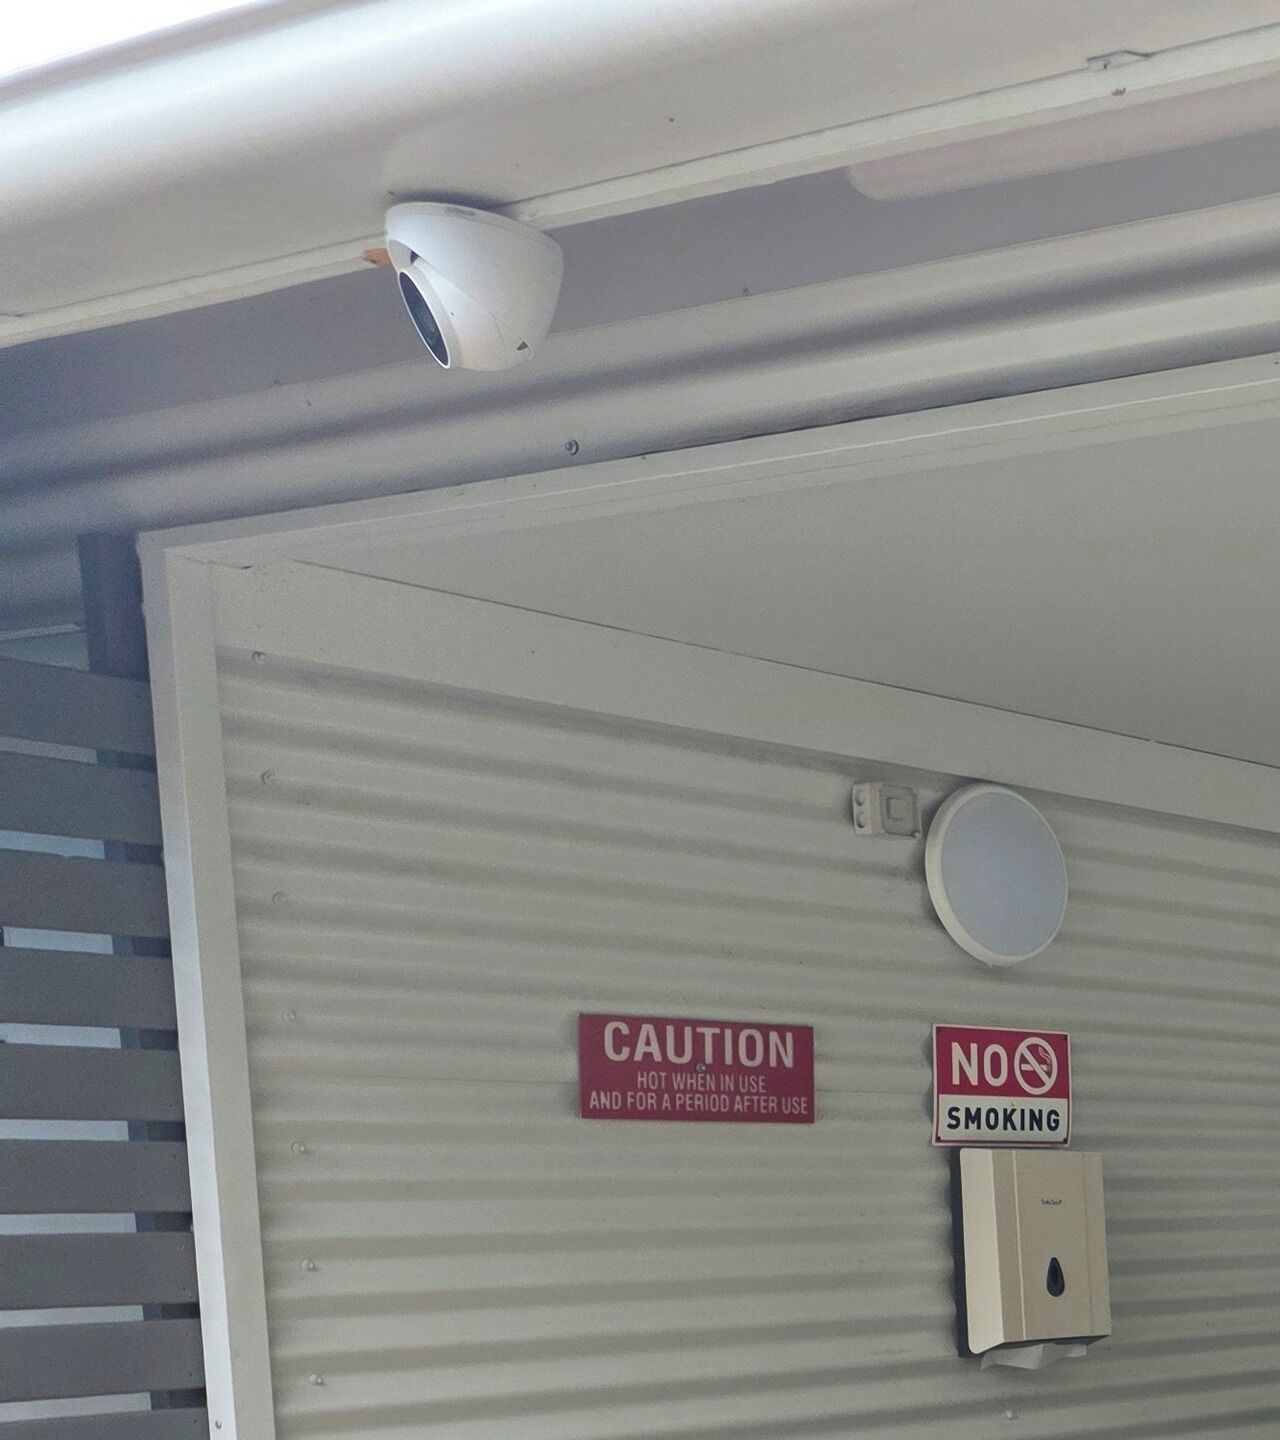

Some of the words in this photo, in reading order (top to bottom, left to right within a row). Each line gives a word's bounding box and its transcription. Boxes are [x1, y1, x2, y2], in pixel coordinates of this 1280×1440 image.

[604, 1021, 794, 1068] CAUTION
[951, 1041, 1008, 1087] NO
[637, 1071, 667, 1090] HOT
[672, 1073, 716, 1091] WHEN
[720, 1074, 735, 1092] IN
[739, 1076, 766, 1093] USE
[589, 1090, 621, 1110] AND
[627, 1092, 657, 1111] FOR
[662, 1093, 672, 1111] A
[676, 1094, 729, 1112] PERIOD
[734, 1096, 777, 1113] AFTER
[782, 1097, 808, 1115] USE
[947, 1106, 1060, 1132] SMOKING
